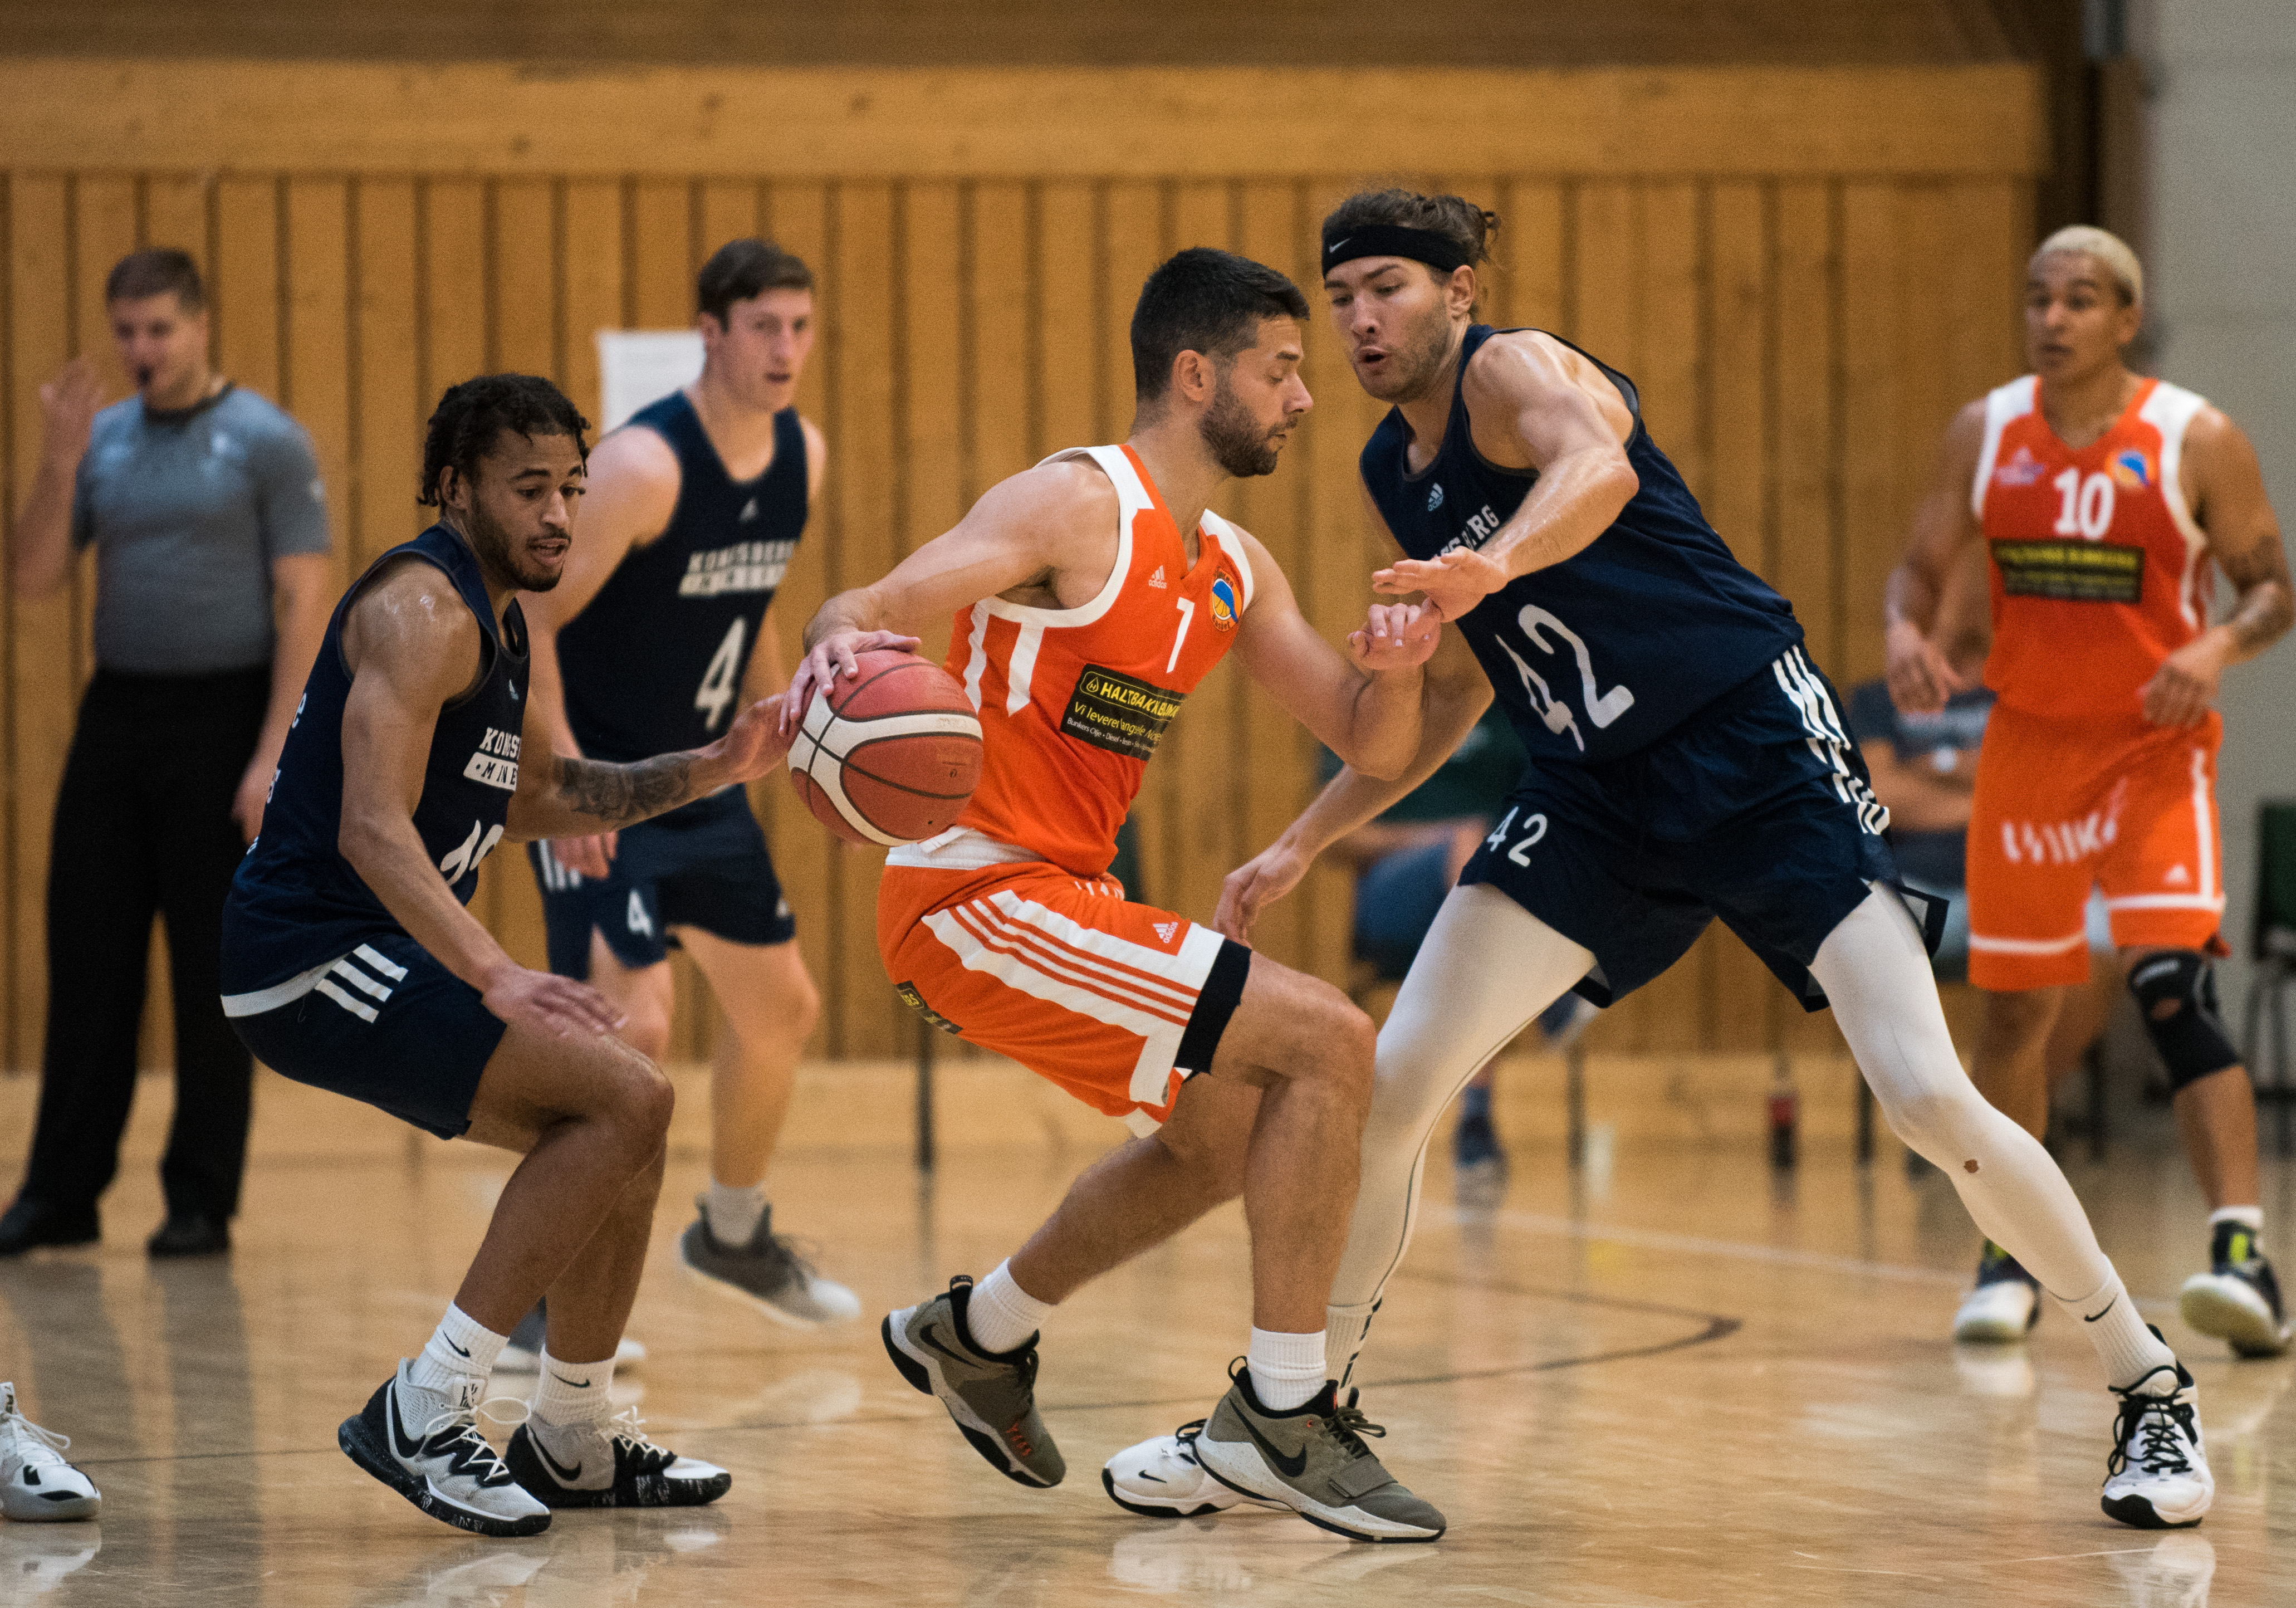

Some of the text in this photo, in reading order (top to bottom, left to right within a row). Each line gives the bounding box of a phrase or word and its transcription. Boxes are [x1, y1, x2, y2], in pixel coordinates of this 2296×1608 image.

[2054, 467, 2114, 540] 10
[1148, 579, 1167, 589] adidas
[1166, 597, 1195, 673] 7
[695, 617, 746, 731] 4
[1495, 604, 1634, 752] 42
[1067, 717, 1090, 732] Bunkers
[1075, 701, 1086, 715] Vi
[1487, 805, 1548, 867] 42
[627, 889, 653, 938] 4
[1163, 921, 1178, 944] adidas
